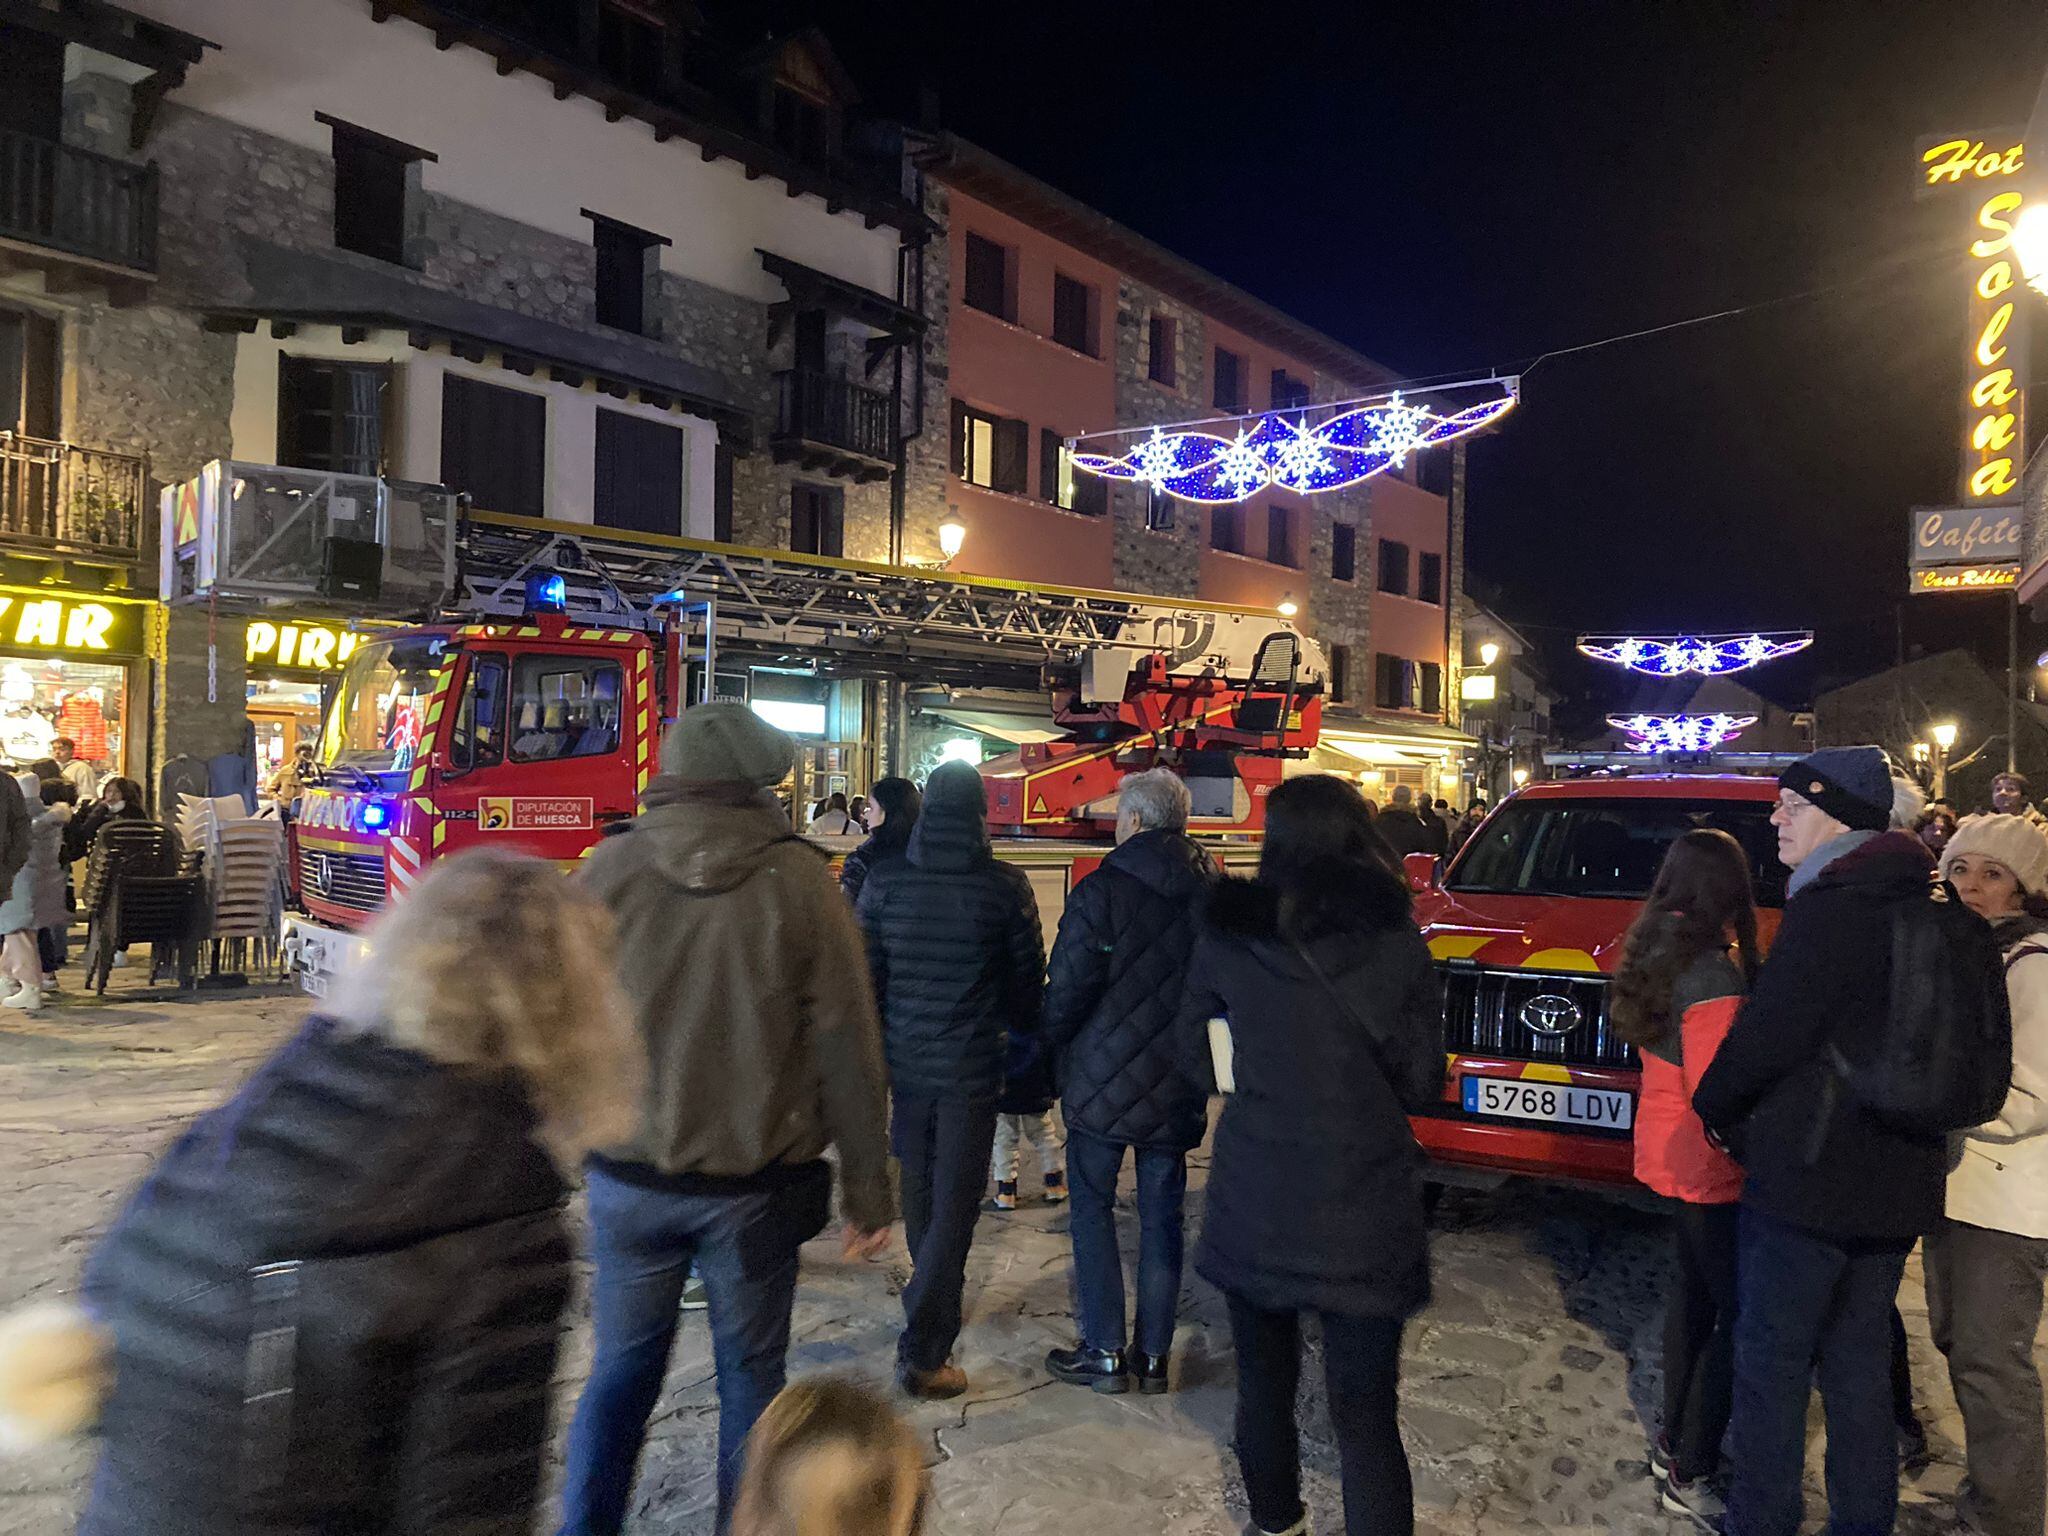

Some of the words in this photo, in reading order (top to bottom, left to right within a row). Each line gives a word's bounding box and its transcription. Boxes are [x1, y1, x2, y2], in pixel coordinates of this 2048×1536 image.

[1922, 139, 2024, 184] Hot
[1969, 191, 2022, 497] Solana
[516, 801, 582, 813] DIPUTACIÓN
[516, 815, 532, 825] DE
[534, 814, 582, 825] HUESCA
[1485, 1084, 1557, 1116] 5768
[1567, 1092, 1622, 1123] LDV
